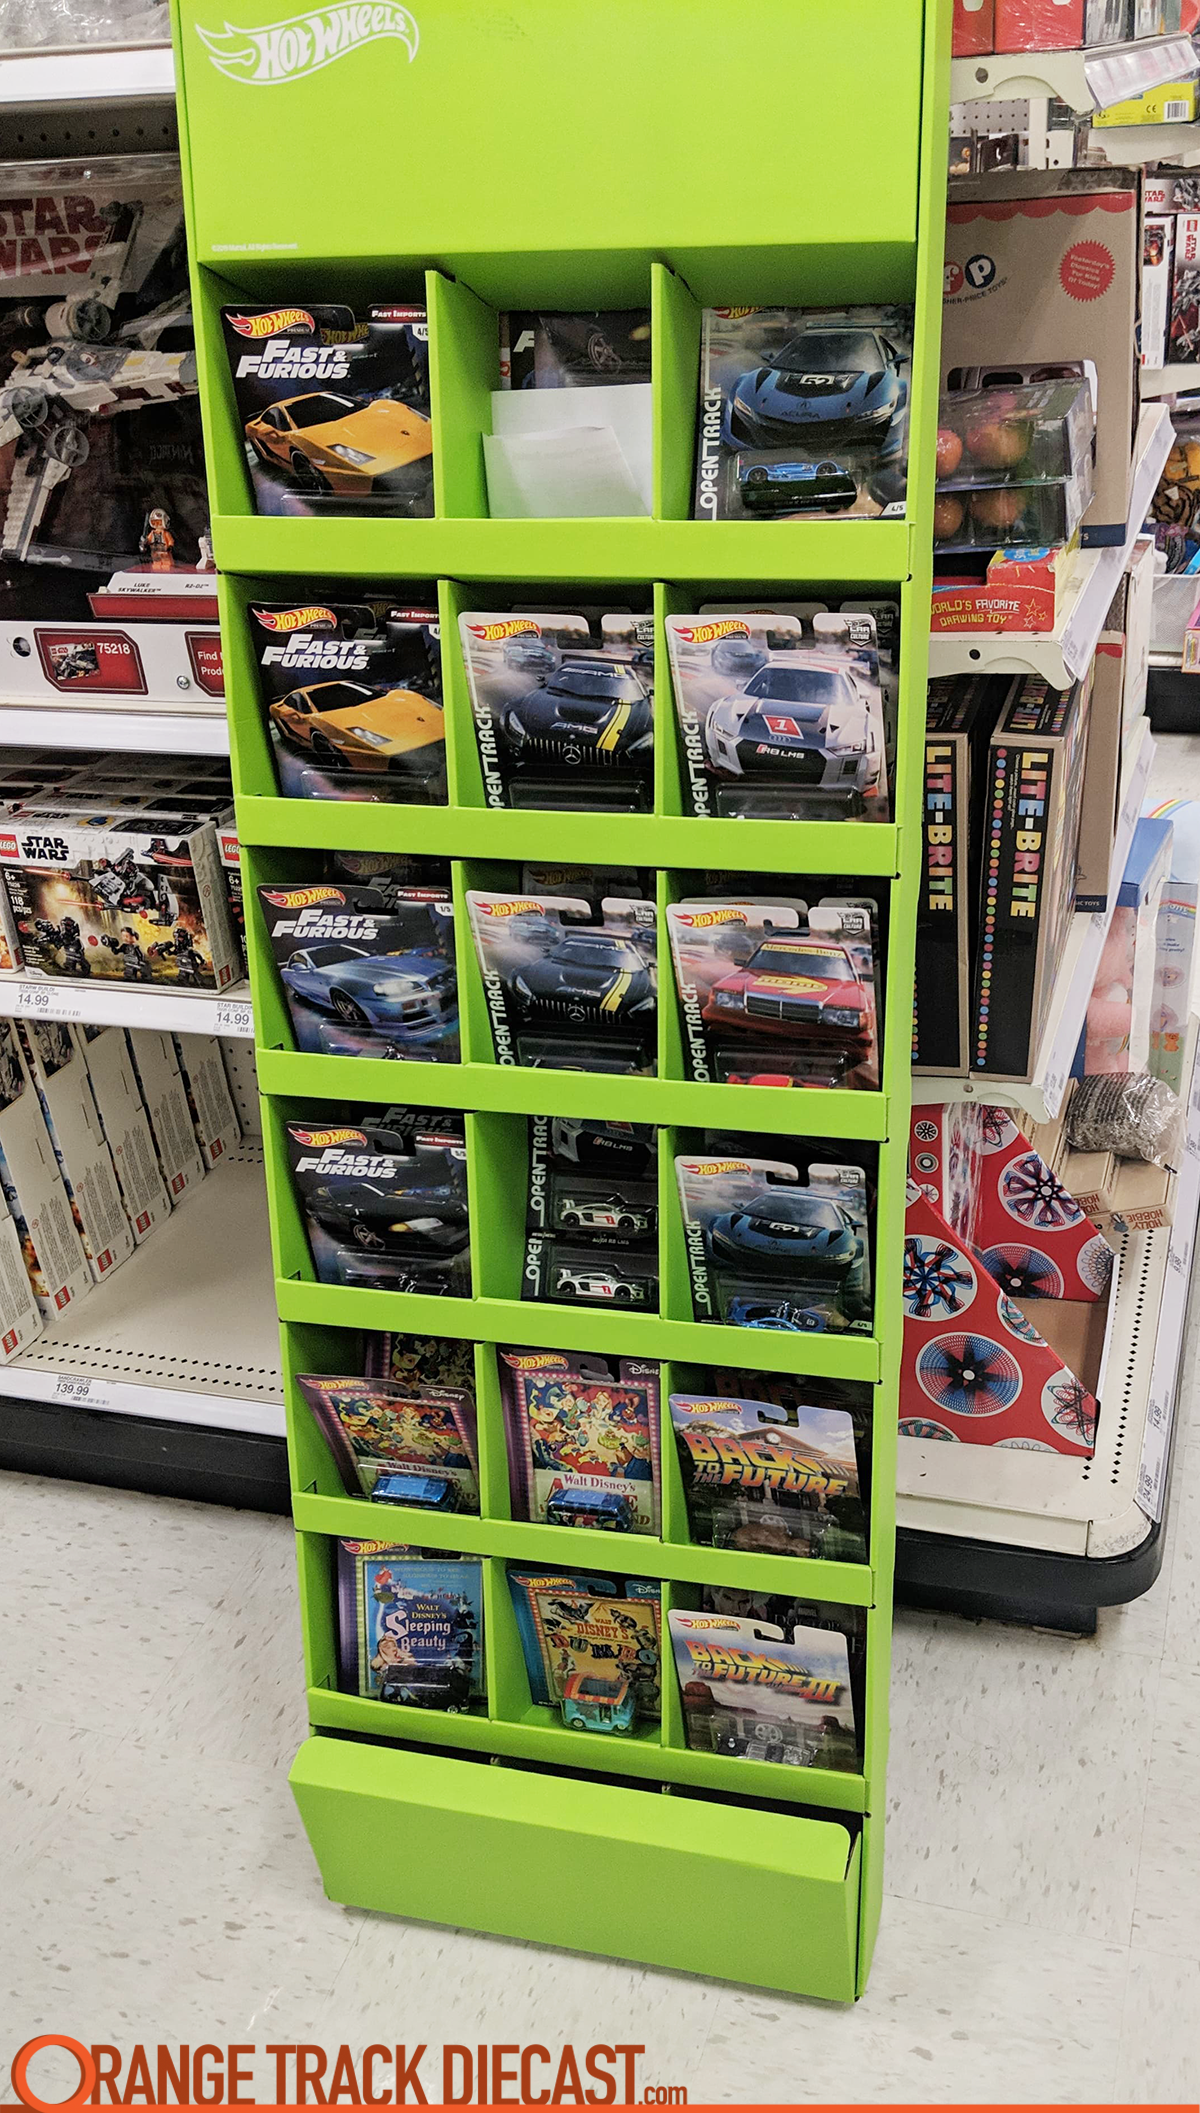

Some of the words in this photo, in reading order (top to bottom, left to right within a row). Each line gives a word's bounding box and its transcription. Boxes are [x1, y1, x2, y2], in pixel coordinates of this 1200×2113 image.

[0, 196, 107, 237] TAR
[371, 310, 391, 318] FAST
[262, 340, 333, 363] FAST
[334, 351, 347, 363] &
[235, 355, 350, 380] FURIOUS
[97, 642, 131, 655] 75218
[286, 634, 354, 655] FAST
[353, 644, 367, 656] &
[197, 651, 218, 661] Find
[261, 646, 370, 670] FURIOUS
[550, 722, 598, 734] AMG
[926, 746, 954, 911] LITE-BRITE
[1010, 752, 1049, 918] LITE-BRITE
[21, 836, 68, 850] STAR
[23, 848, 69, 861] WARS
[11, 895, 24, 906] 118
[297, 909, 363, 927] FAST
[363, 918, 376, 928] &
[271, 921, 379, 941] FURIOUS
[18, 993, 49, 1007] 14.99
[216, 1012, 250, 1026] 14.99
[295, 1157, 398, 1179] FURIOUS
[320, 1149, 383, 1168] FAST
[383, 1159, 394, 1168] &
[56, 1383, 90, 1396] 139.99
[682, 1432, 820, 1476] BACK
[694, 1461, 720, 1474] TO
[564, 1473, 588, 1487] Walt
[721, 1464, 848, 1496] FUTURE
[385, 1610, 451, 1640] Sleeping
[401, 1636, 446, 1652] Beauty
[684, 1640, 776, 1672] BACK
[711, 1663, 808, 1688] FUTURE
